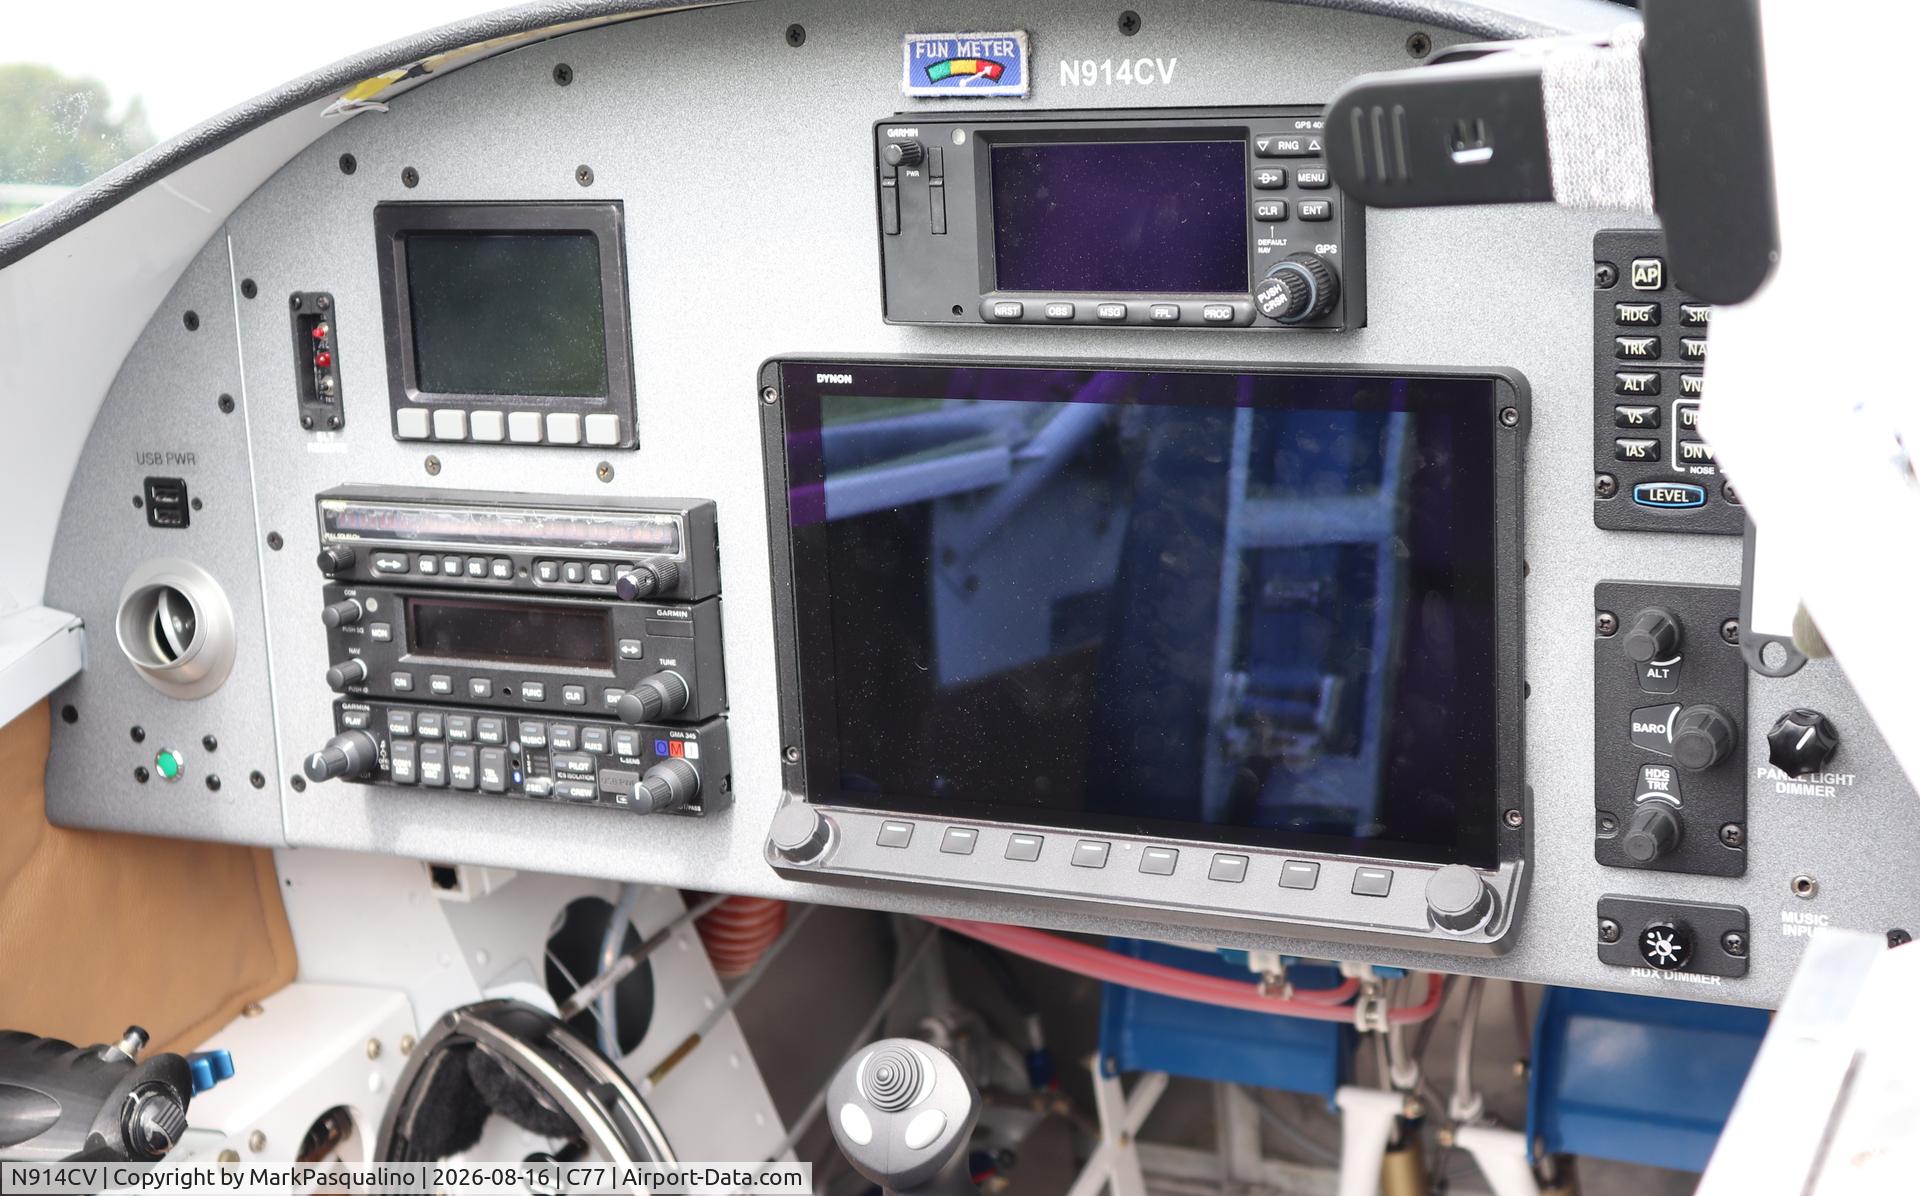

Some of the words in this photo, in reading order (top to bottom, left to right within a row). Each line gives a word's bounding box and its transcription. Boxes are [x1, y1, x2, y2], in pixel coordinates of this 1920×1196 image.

[916, 42, 948, 58] FUN
[958, 40, 1015, 58] METER
[1060, 58, 1177, 86] N914CV
[1294, 121, 1312, 129] GPS
[887, 128, 918, 138] GARMIN
[1278, 141, 1299, 150] RNG
[1298, 173, 1325, 182] MENU
[1258, 206, 1278, 216] CLR
[1303, 206, 1322, 214] ENT
[1315, 244, 1338, 254] GPS
[1635, 268, 1658, 282] AP
[1257, 284, 1282, 304] PUSH
[1262, 293, 1288, 313] CRSR
[994, 306, 1018, 316] NRST
[1048, 307, 1068, 316] OBS
[1100, 308, 1121, 316] MSG
[1155, 308, 1171, 317] FPL
[1204, 308, 1230, 318] PROC
[1621, 310, 1648, 321] HDG
[1624, 344, 1646, 354] TRK
[1688, 344, 1707, 356] NA
[816, 374, 852, 384] DYNON
[1624, 380, 1646, 391] ALT
[1628, 412, 1643, 424] VS
[1626, 446, 1646, 458] IAS
[1684, 446, 1702, 458] DN
[136, 452, 162, 466] USB
[166, 452, 196, 466] PWR
[1690, 466, 1715, 474] NOSE
[1650, 489, 1689, 502] LEVEL
[656, 610, 688, 618] GARMIN
[659, 658, 677, 666] TUNE
[1646, 668, 1670, 678] ALT
[522, 688, 542, 697] FUNC
[566, 692, 580, 700] CLR
[342, 704, 370, 712] GARMIN
[390, 724, 408, 733] COM1
[418, 727, 438, 736] COM2
[1632, 722, 1666, 734] BARO
[553, 740, 570, 748] AUX1
[568, 762, 589, 771] PILOT
[1645, 768, 1670, 778] HDG
[1811, 773, 1856, 786] LIGHT
[1646, 780, 1669, 791] TRK
[1776, 782, 1836, 798] DIMMER
[570, 788, 592, 797] CREW
[1782, 910, 1829, 926] MUSIC
[1631, 967, 1660, 980] HDX
[1664, 972, 1722, 986] DIMMER
